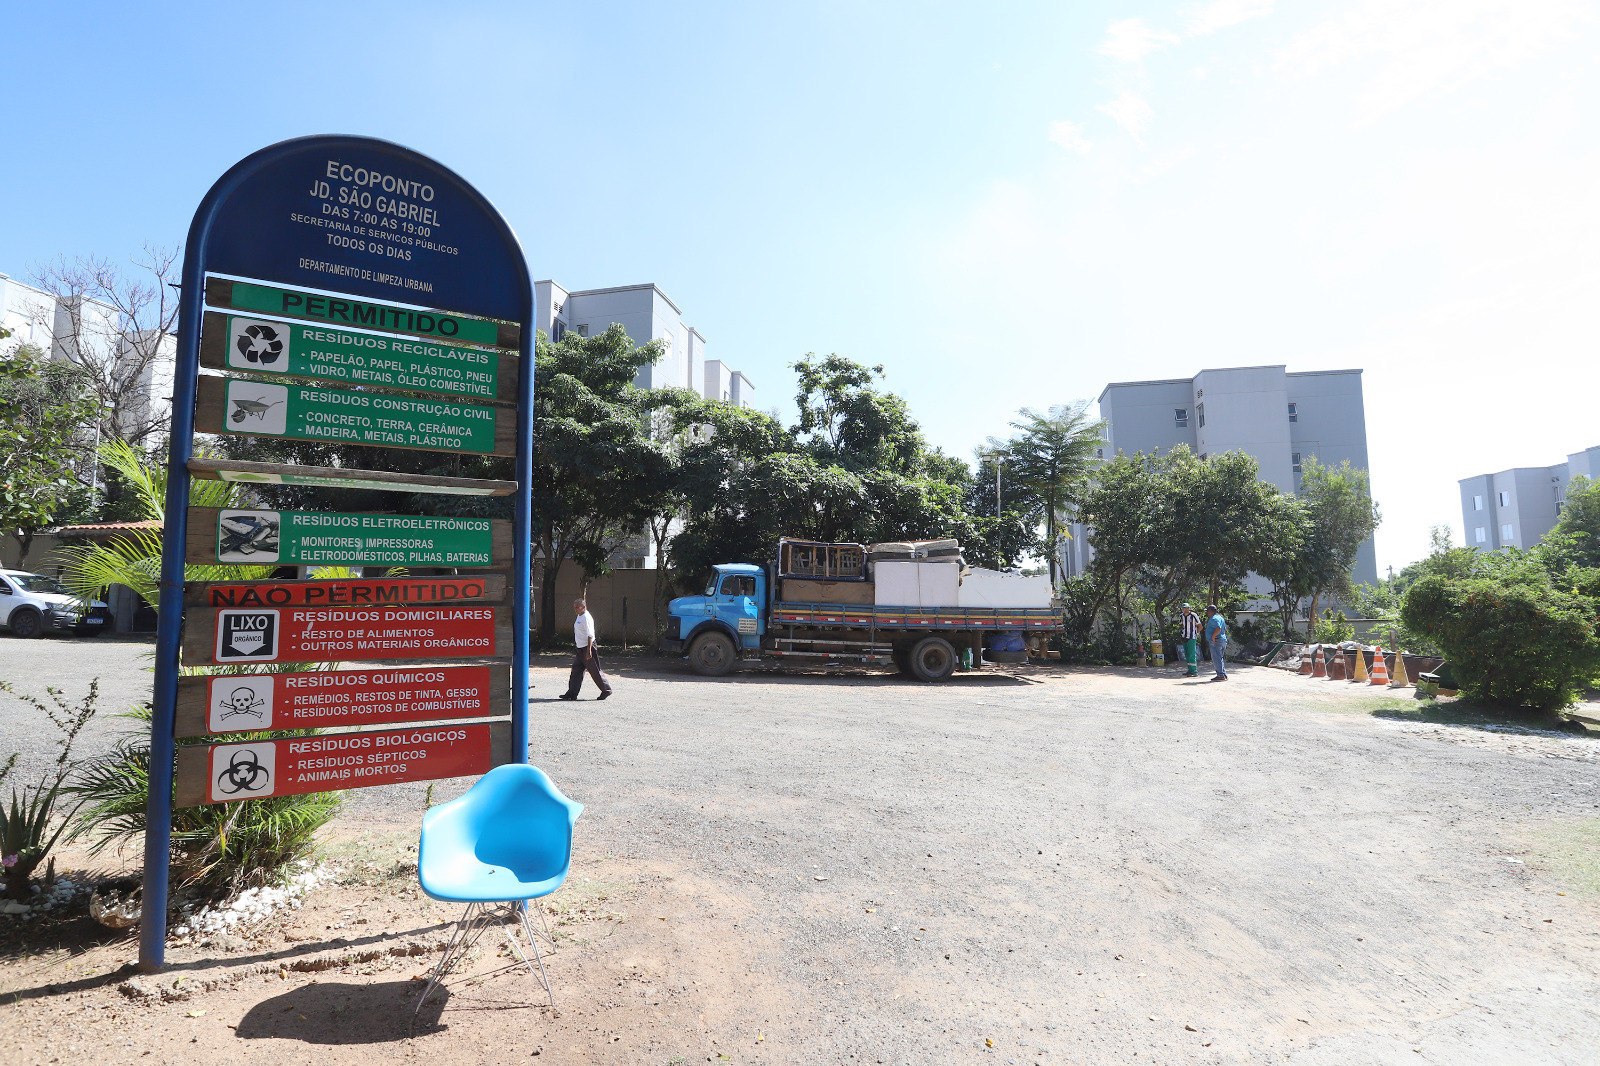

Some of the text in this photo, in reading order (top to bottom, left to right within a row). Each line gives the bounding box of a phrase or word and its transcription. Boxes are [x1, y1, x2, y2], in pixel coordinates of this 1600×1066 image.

[326, 160, 435, 202] ECOPONTO
[309, 180, 441, 227] JD. SÃO GABRIEL
[322, 203, 431, 237] DAS 7:00 AS 19:00
[290, 213, 351, 232] SECRETARIA
[353, 226, 366, 235] DE
[415, 239, 458, 255] PÚBLICOS
[327, 233, 412, 261] TODOS OS DIAS
[299, 258, 433, 293] DEPARTAMENTO DE LIMPEZA URBANA
[281, 292, 459, 336] PERMITIDO
[302, 330, 489, 364] RESÍDUOS RECICLÁVEIS
[310, 351, 492, 383] PAPELÃO, PAPEL, PLÁSTICO, PNEU
[310, 364, 493, 395] VIDRO, METAIS, ÓLEO COMESTÍVEL
[300, 390, 493, 420] RESÍDUOS CONSTRUÇÃO CIVIL
[306, 412, 473, 436] CONCRETO, TERRA, CERÂMICA
[305, 425, 461, 448] MADEIRA, METAIS, PLÁSTICO
[292, 514, 490, 531] RESÍDUOS ELETROELETRÔNICOS
[366, 538, 434, 549] IMPRESSORAS
[300, 548, 489, 563] ELETRODOMÉSTICOS, PILHAS, BATERIAS
[305, 583, 483, 603] PERMITIDO
[230, 616, 268, 630] LIXO
[293, 610, 492, 622] RESÍDUOS DOMICILIARES
[300, 638, 490, 650] OUTROS MATERIAIS ORGÂNICOS
[301, 629, 434, 640] RESTO DE ALIMENTOS
[285, 672, 445, 688] RESÍDUOS QUÍMICOS
[294, 688, 478, 705] REMÉDIOS, RESTOS DE TINTA, GESSO
[293, 699, 480, 718] RESÍDUOS POSTOS DE COMBUSTÍVEIS
[289, 730, 467, 754] RESÍDUOS BIOLÓGICOS
[298, 750, 427, 770] RESÍDUOS SÉPTICOS
[297, 763, 407, 782] ANIMAIS MORTOS
